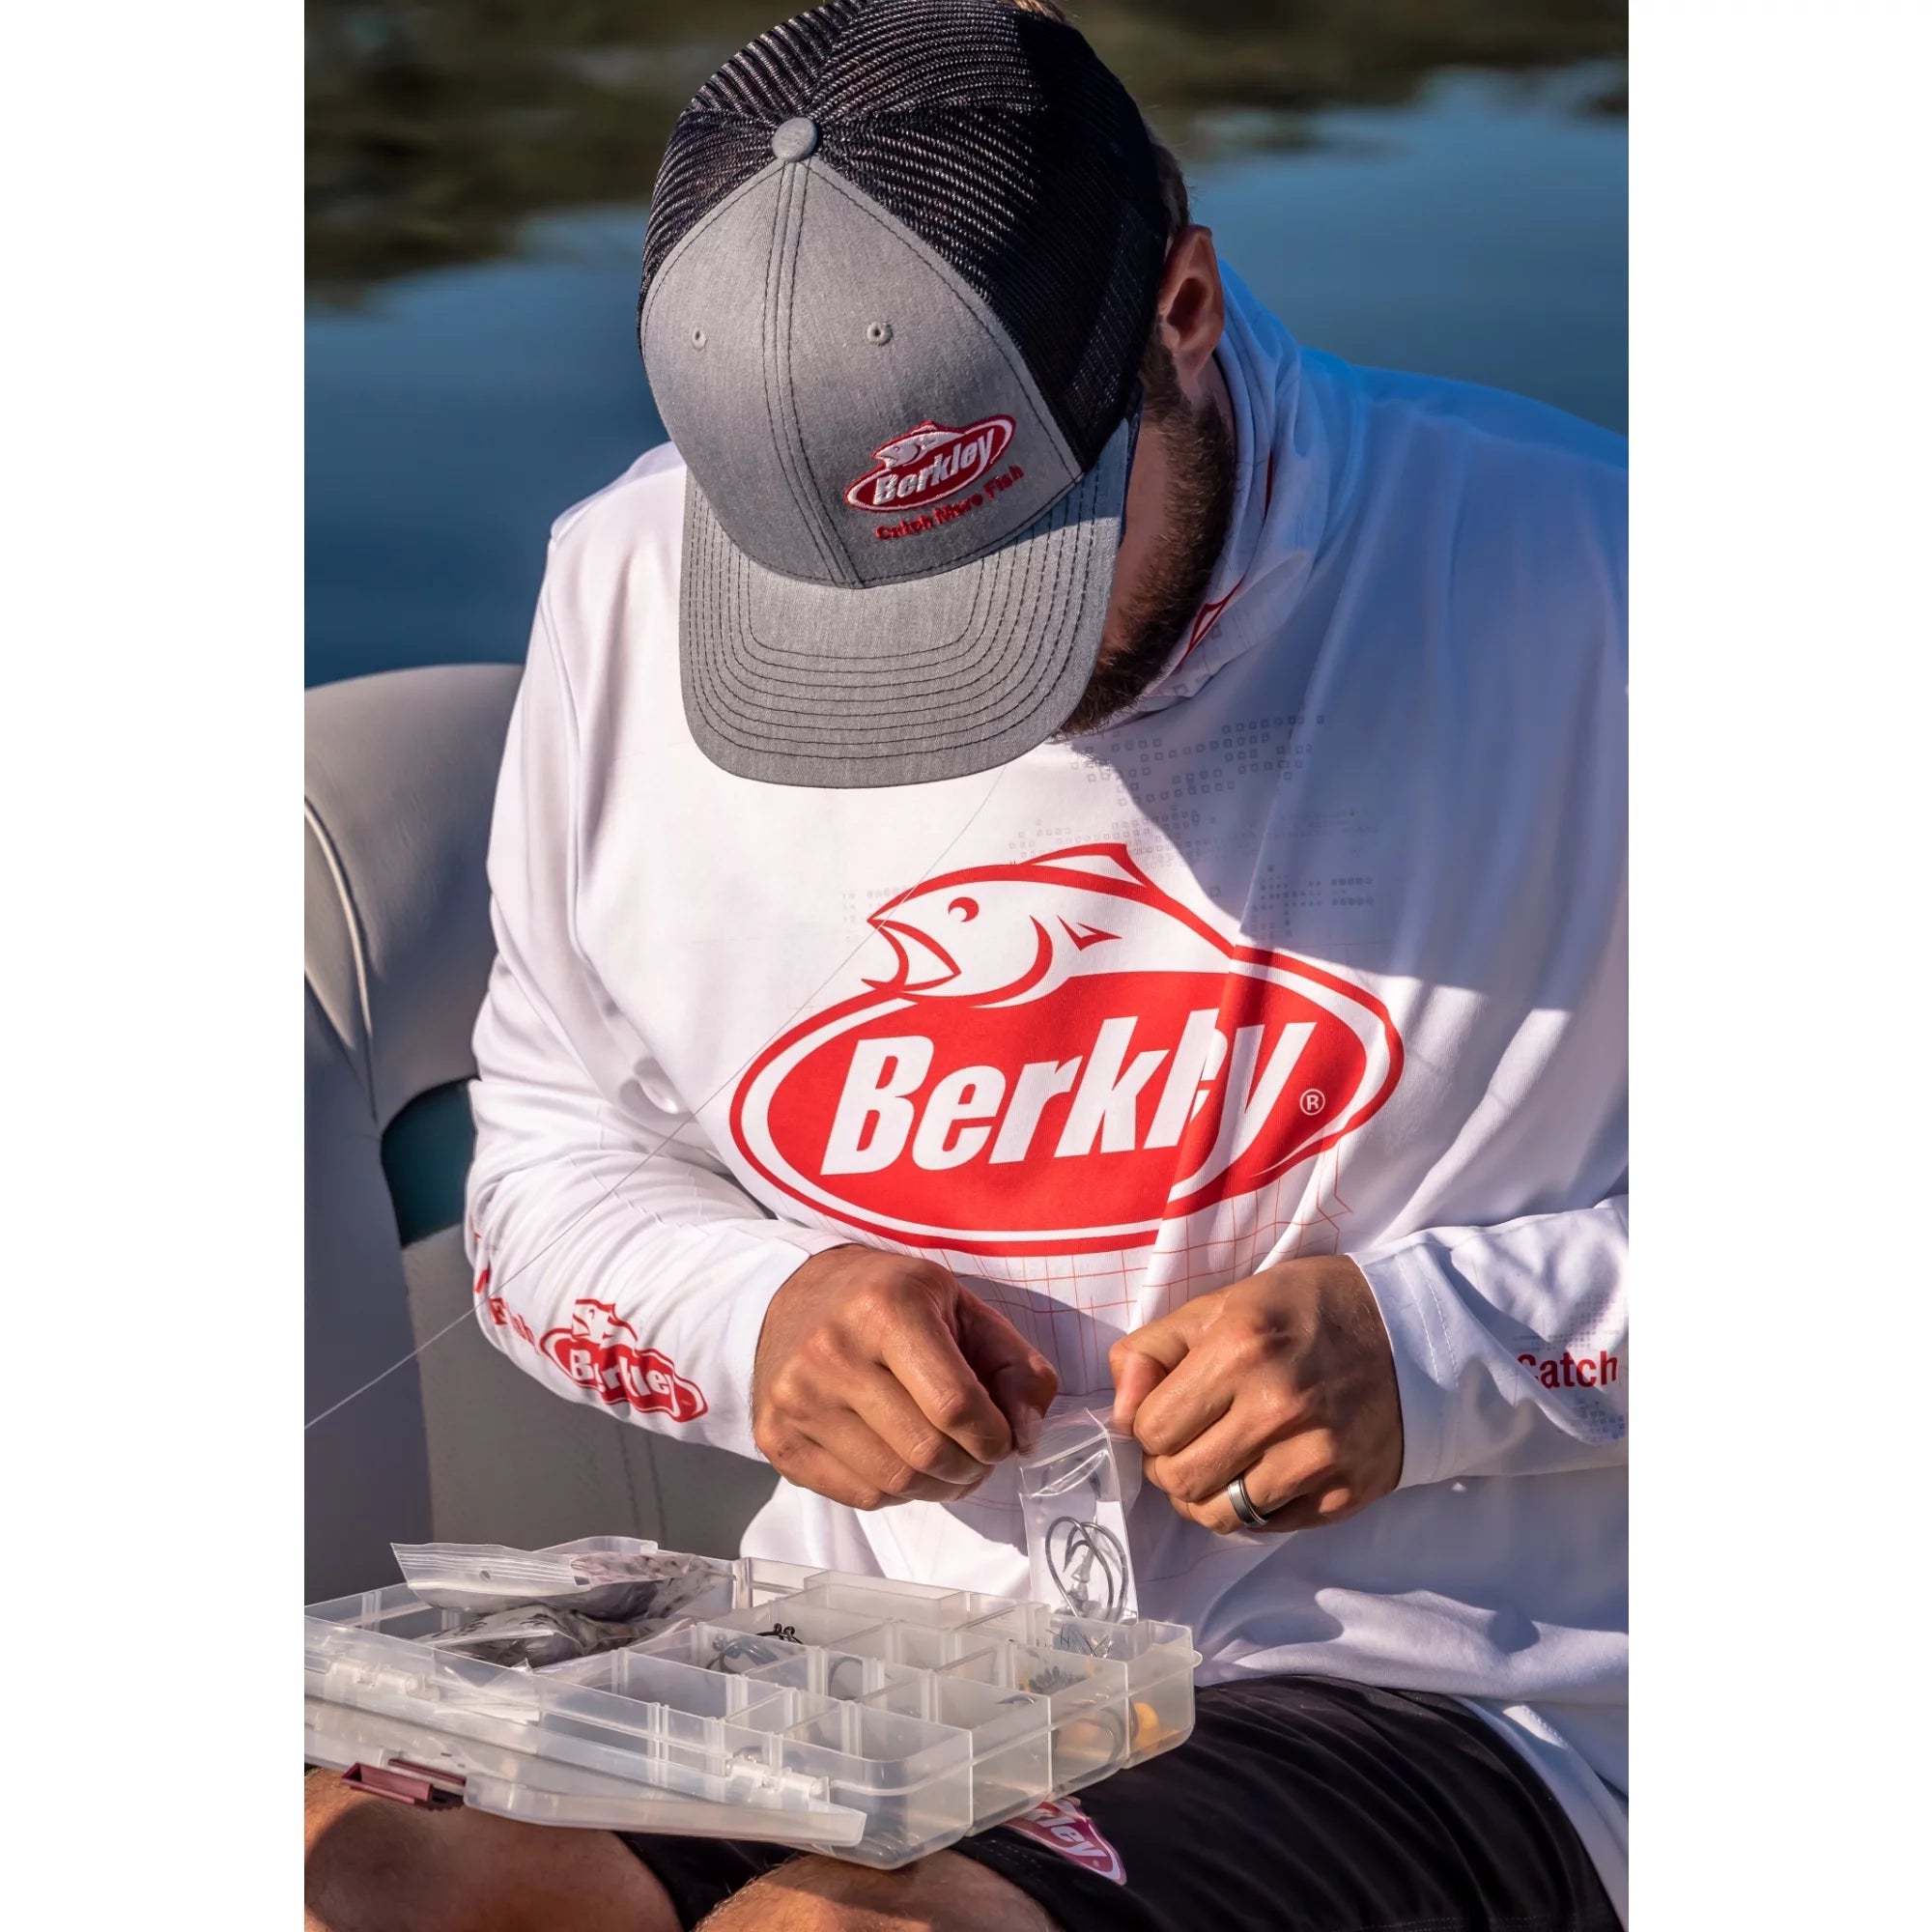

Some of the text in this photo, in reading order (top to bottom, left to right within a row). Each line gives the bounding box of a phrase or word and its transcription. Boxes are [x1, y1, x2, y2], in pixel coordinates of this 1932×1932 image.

[872, 428, 994, 506] Berkley
[874, 465, 1026, 541] Catch More Fish
